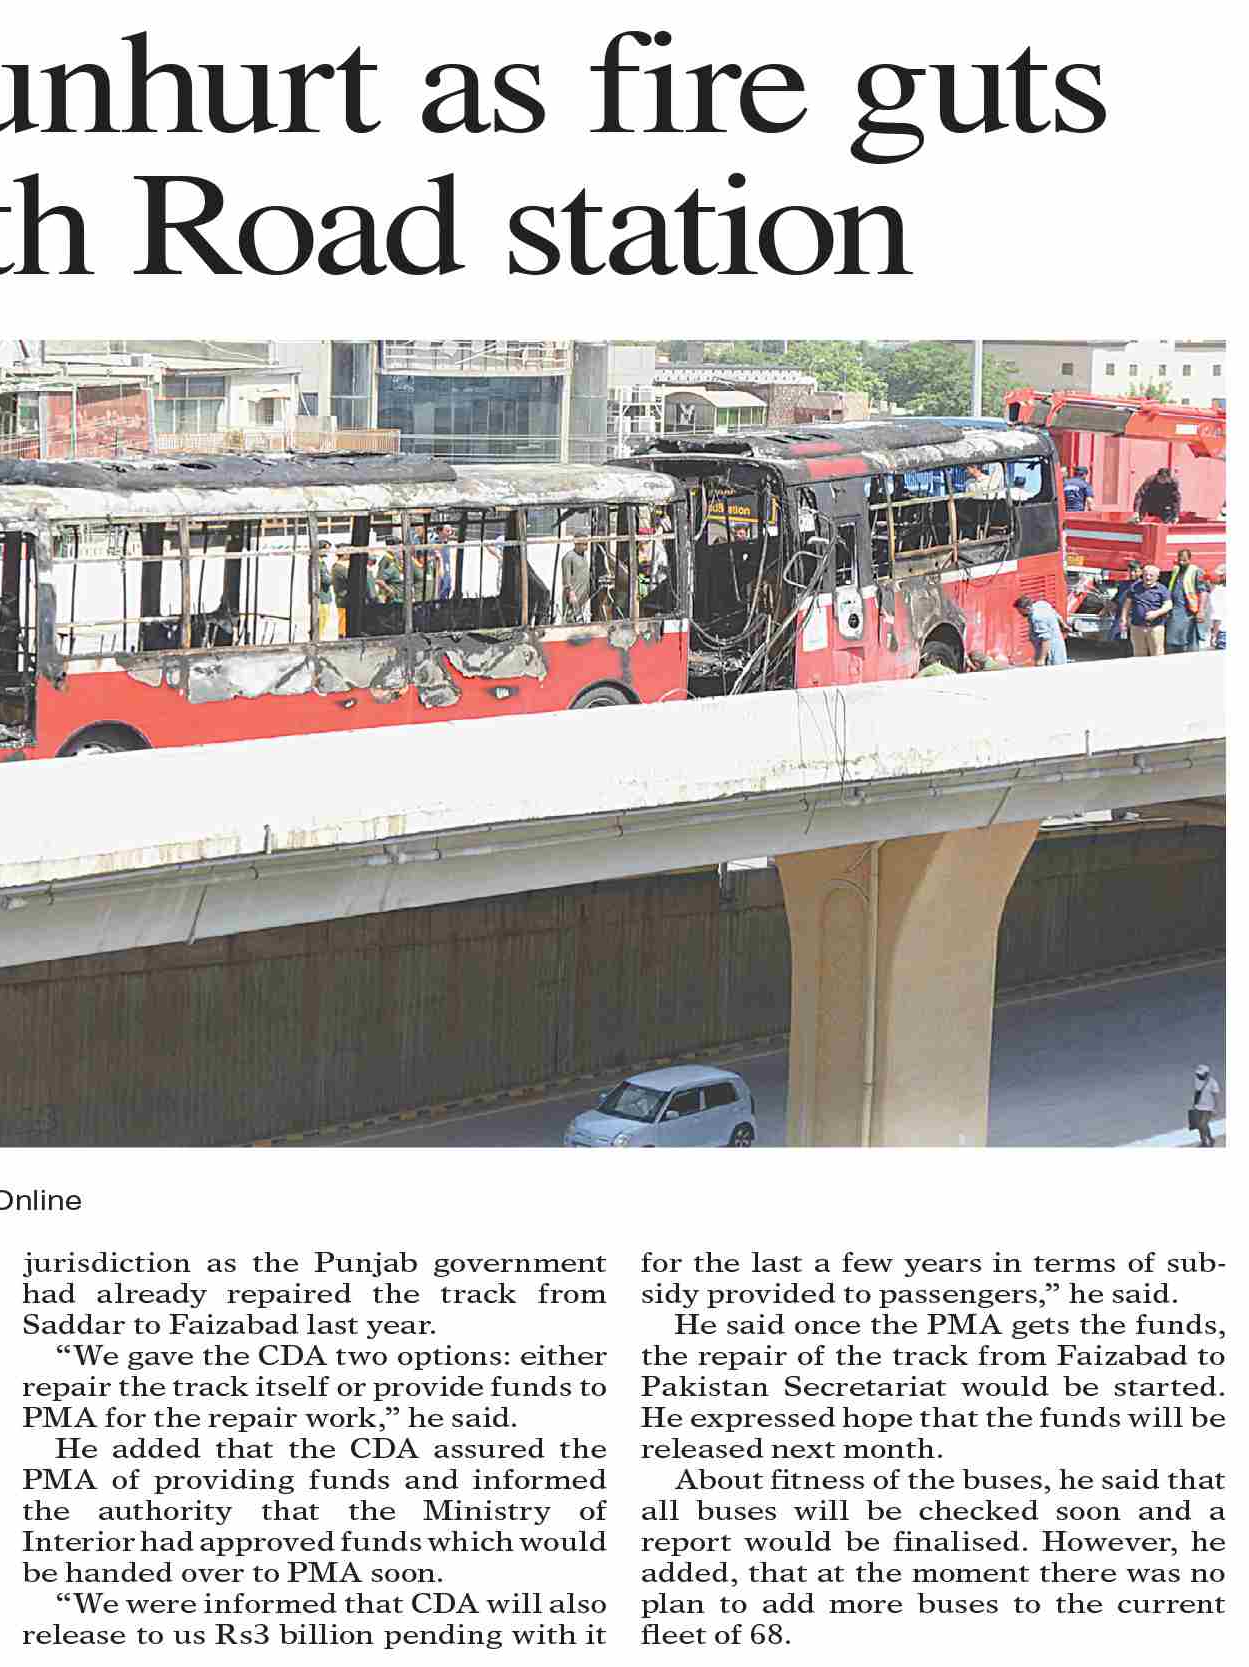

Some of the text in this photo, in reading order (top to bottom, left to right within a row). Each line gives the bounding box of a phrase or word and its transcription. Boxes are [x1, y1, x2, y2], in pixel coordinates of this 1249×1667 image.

[421, 63, 546, 134] as
[590, 30, 808, 134] fire
[850, 45, 1107, 165] guts
[133, 172, 466, 276] Road
[508, 172, 914, 276] station
[22, 1251, 607, 1278] jurisdiction as the Punjab government
[641, 1282, 1178, 1309] sidy provided to passengers,” he said.
[56, 1344, 608, 1371] “We gave the CDA two options: either
[640, 1375, 1225, 1397] Pakistan Secretariat would be started.
[22, 1530, 607, 1557] Interior had approved funds which would
[641, 1530, 1226, 1557] report would be finalised. However, he
[22, 1623, 607, 1650] release to us Rs3 billion pending with it
[640, 1623, 791, 1645] fleet of 68.
